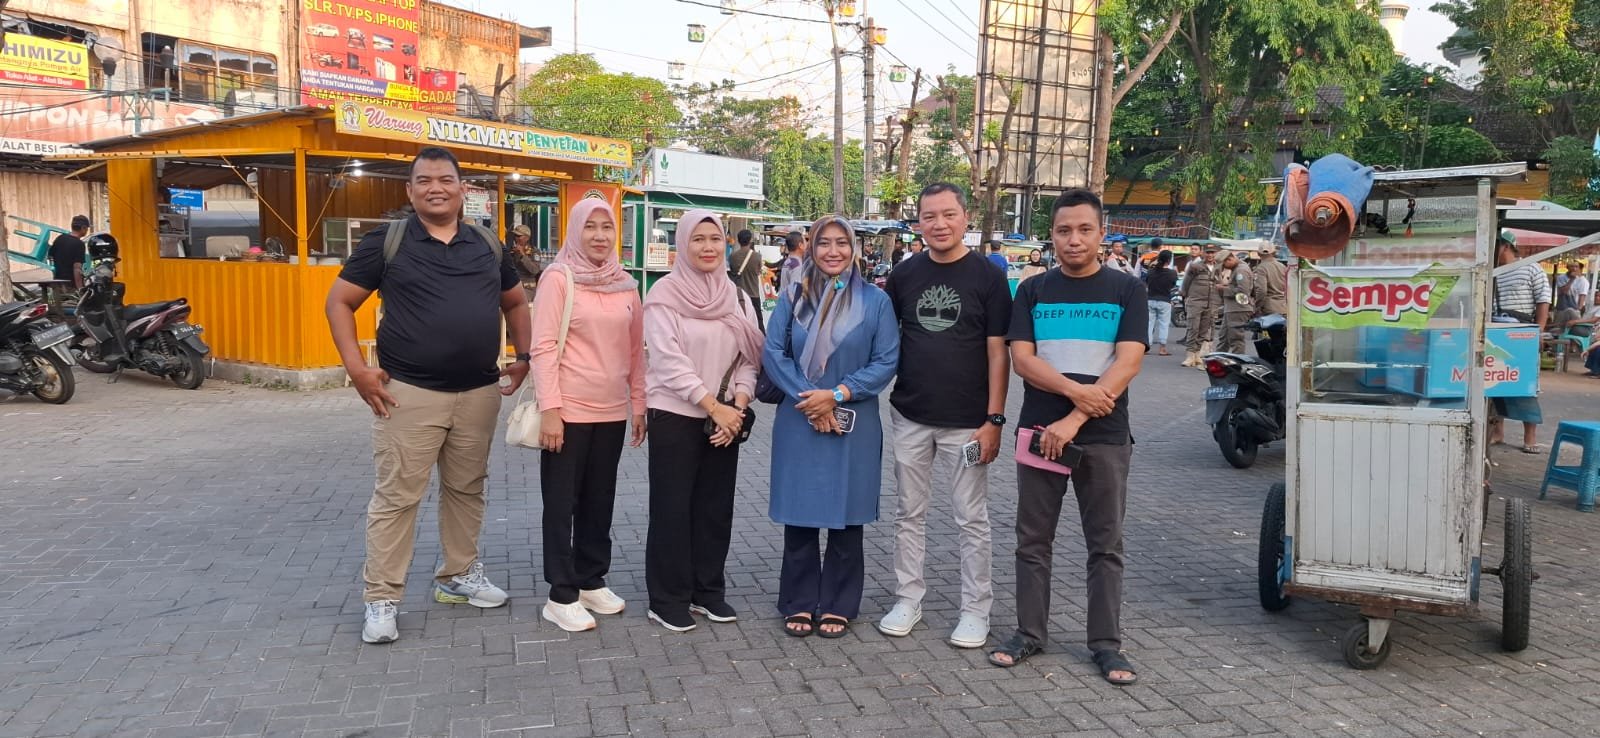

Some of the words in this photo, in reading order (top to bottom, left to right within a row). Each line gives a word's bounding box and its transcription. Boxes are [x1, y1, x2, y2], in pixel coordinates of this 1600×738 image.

[364, 106, 424, 138] Warung
[426, 117, 525, 151] NIKMAT
[526, 130, 588, 153] PENYETAN
[2, 140, 34, 152] ALAT
[35, 143, 57, 153] BESI
[1034, 309, 1065, 320] DEEP
[1069, 309, 1118, 321] IMPACT
[1452, 366, 1519, 382] Merale
